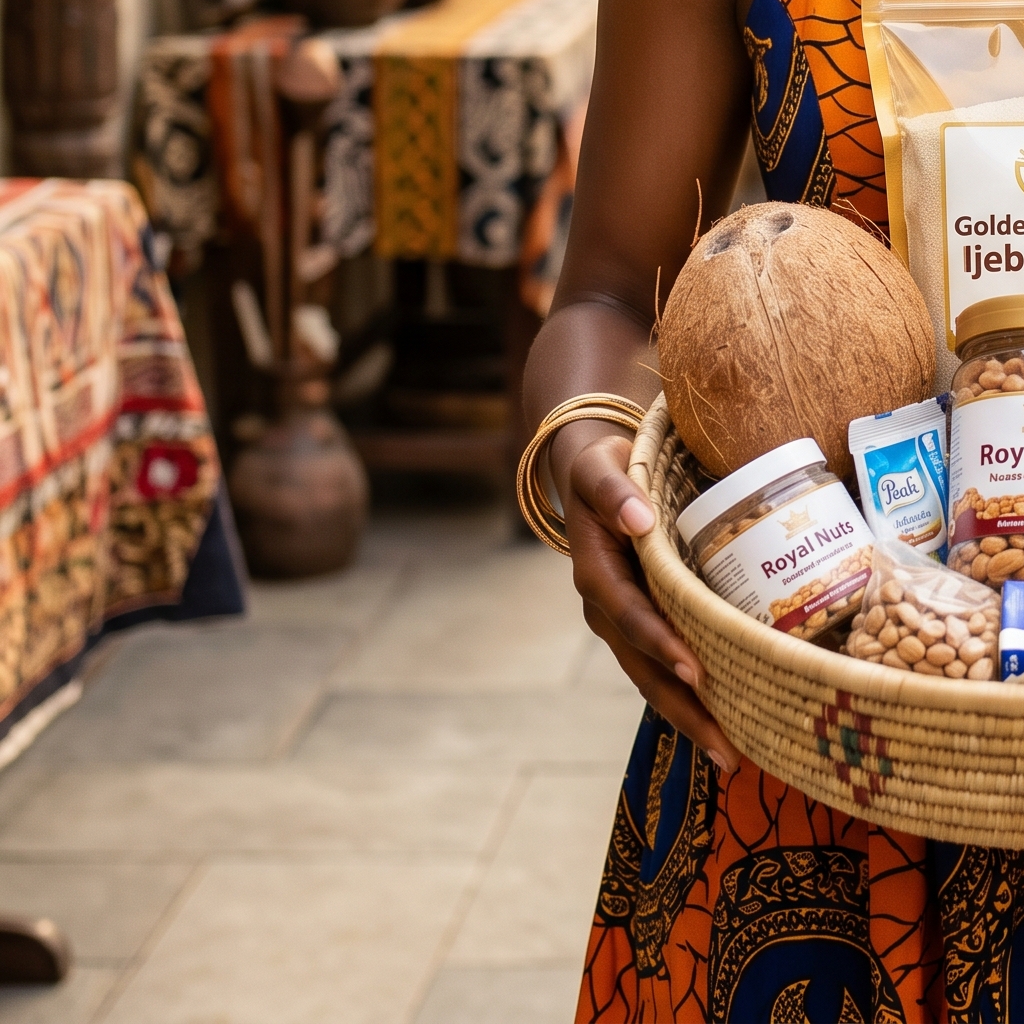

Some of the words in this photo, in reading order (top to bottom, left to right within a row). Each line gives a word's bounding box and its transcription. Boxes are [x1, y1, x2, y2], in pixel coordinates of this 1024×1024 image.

[881, 476, 920, 505] Peak
[760, 536, 815, 579] Royal
[814, 521, 854, 547] Nuts
